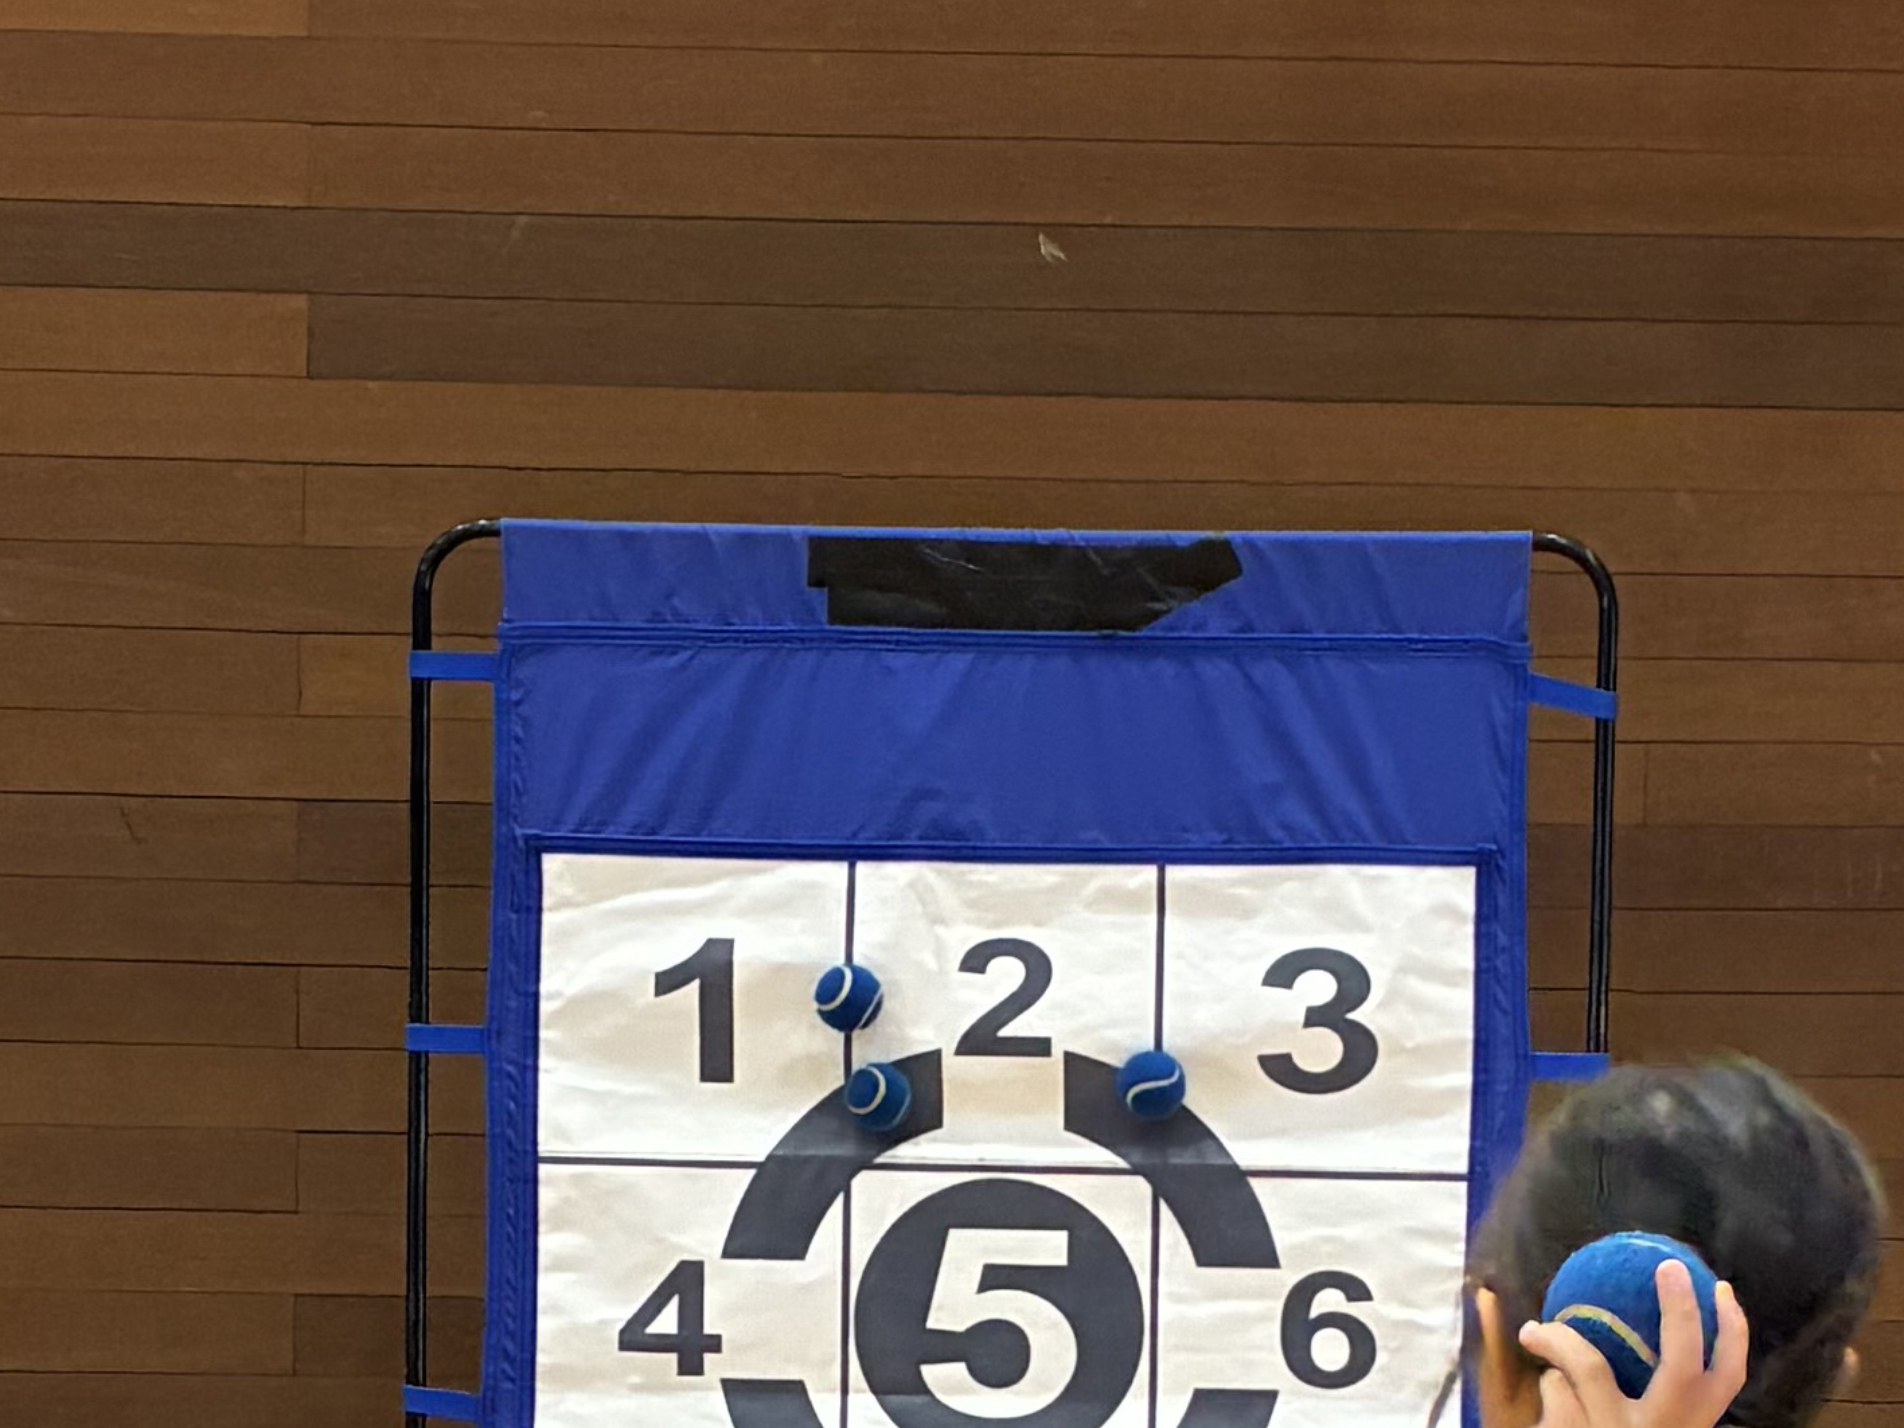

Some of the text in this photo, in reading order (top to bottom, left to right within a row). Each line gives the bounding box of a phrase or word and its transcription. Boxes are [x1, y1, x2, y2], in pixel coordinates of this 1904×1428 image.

[655, 939, 734, 1082] 1
[955, 939, 1051, 1057] 2
[1258, 949, 1378, 1094] 3
[619, 1261, 721, 1376] 4
[920, 1229, 1077, 1419] 5
[1281, 1271, 1376, 1389] 6
